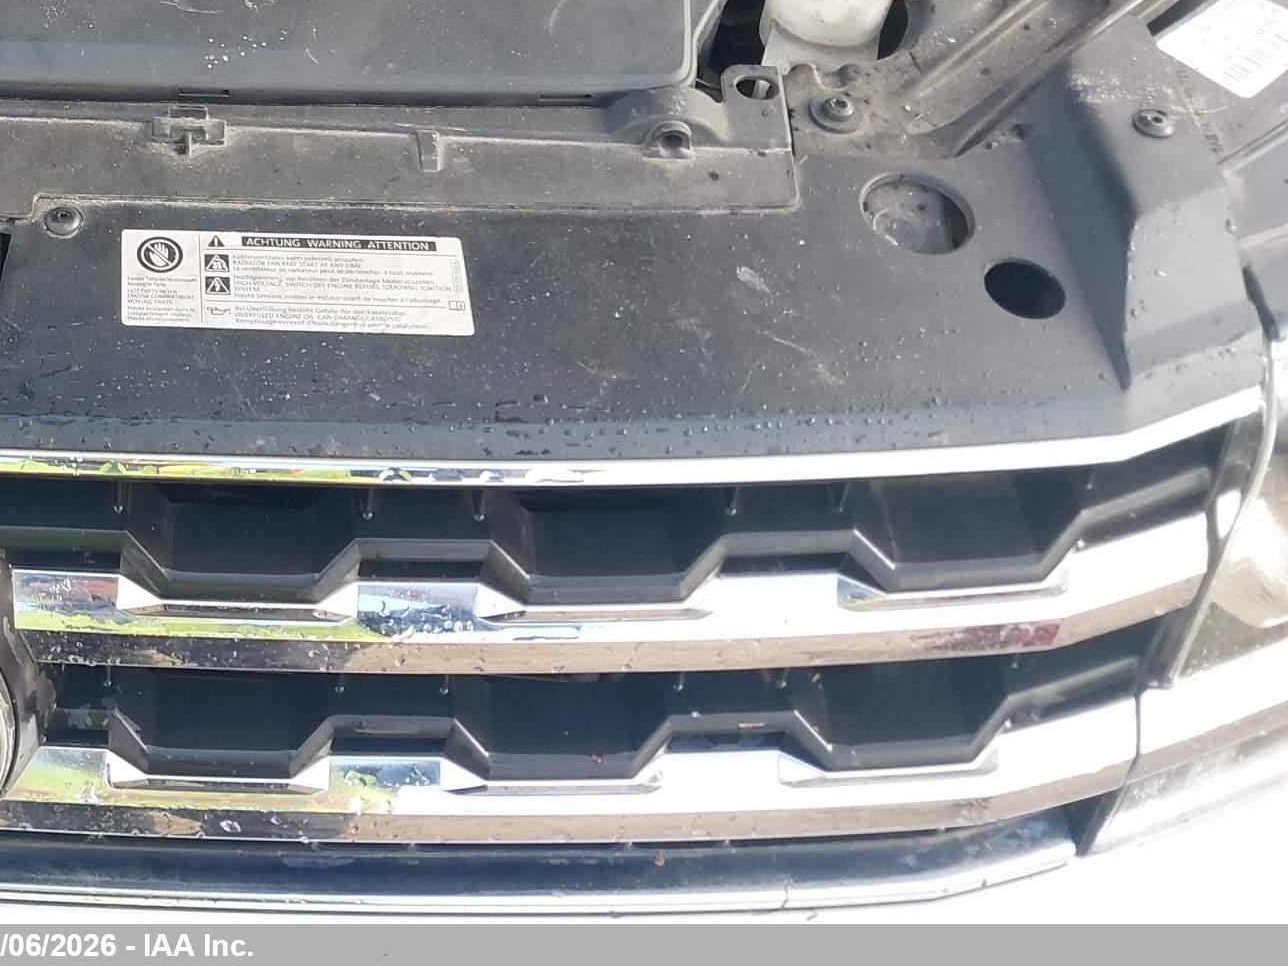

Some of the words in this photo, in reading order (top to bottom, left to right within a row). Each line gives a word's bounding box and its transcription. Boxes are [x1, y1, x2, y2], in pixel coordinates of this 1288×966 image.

[246, 237, 301, 247] ACHTUNG
[306, 238, 361, 248] WARNING
[366, 240, 429, 250] ATTENTION
